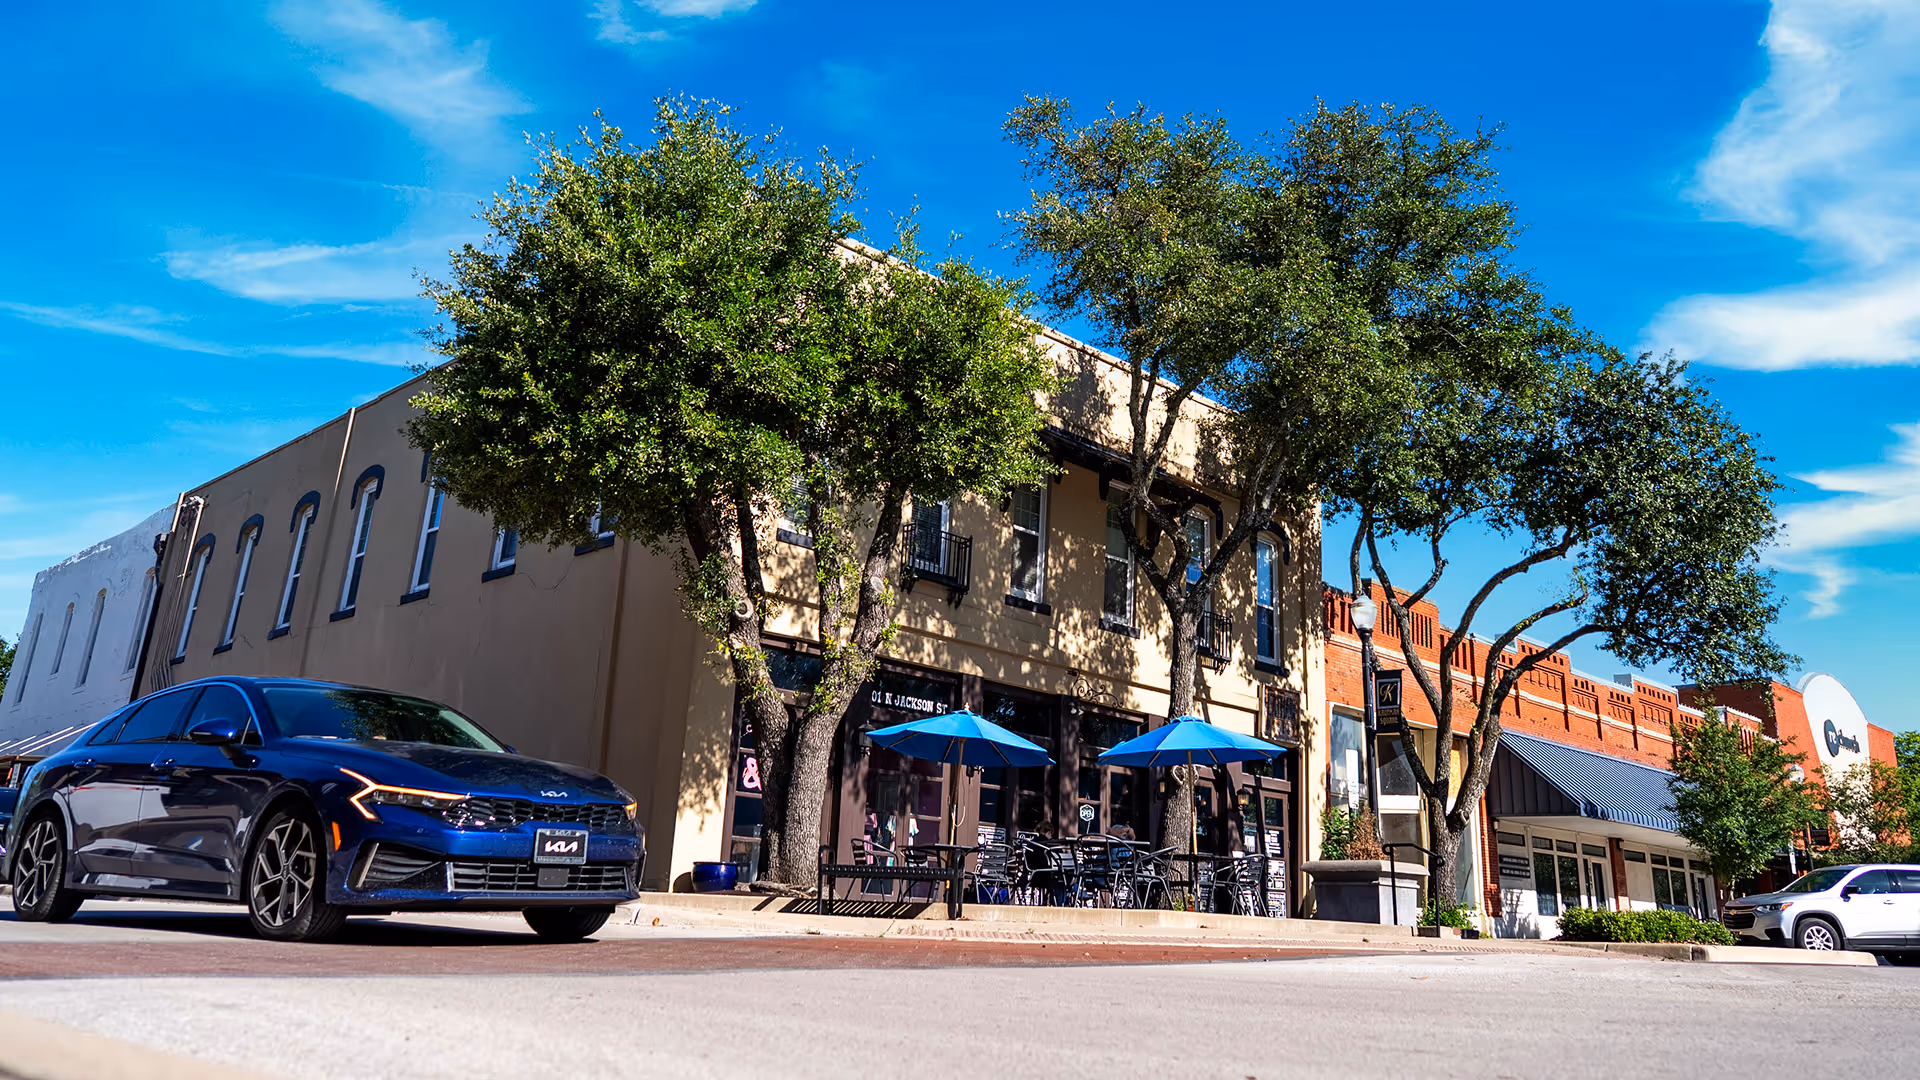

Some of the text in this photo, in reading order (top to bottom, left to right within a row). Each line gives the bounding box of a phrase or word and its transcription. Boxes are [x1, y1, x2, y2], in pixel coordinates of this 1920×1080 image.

[885, 692, 893, 705] N
[894, 695, 934, 712] JACKSON
[936, 702, 948, 714] ST
[545, 840, 578, 852] KIA
